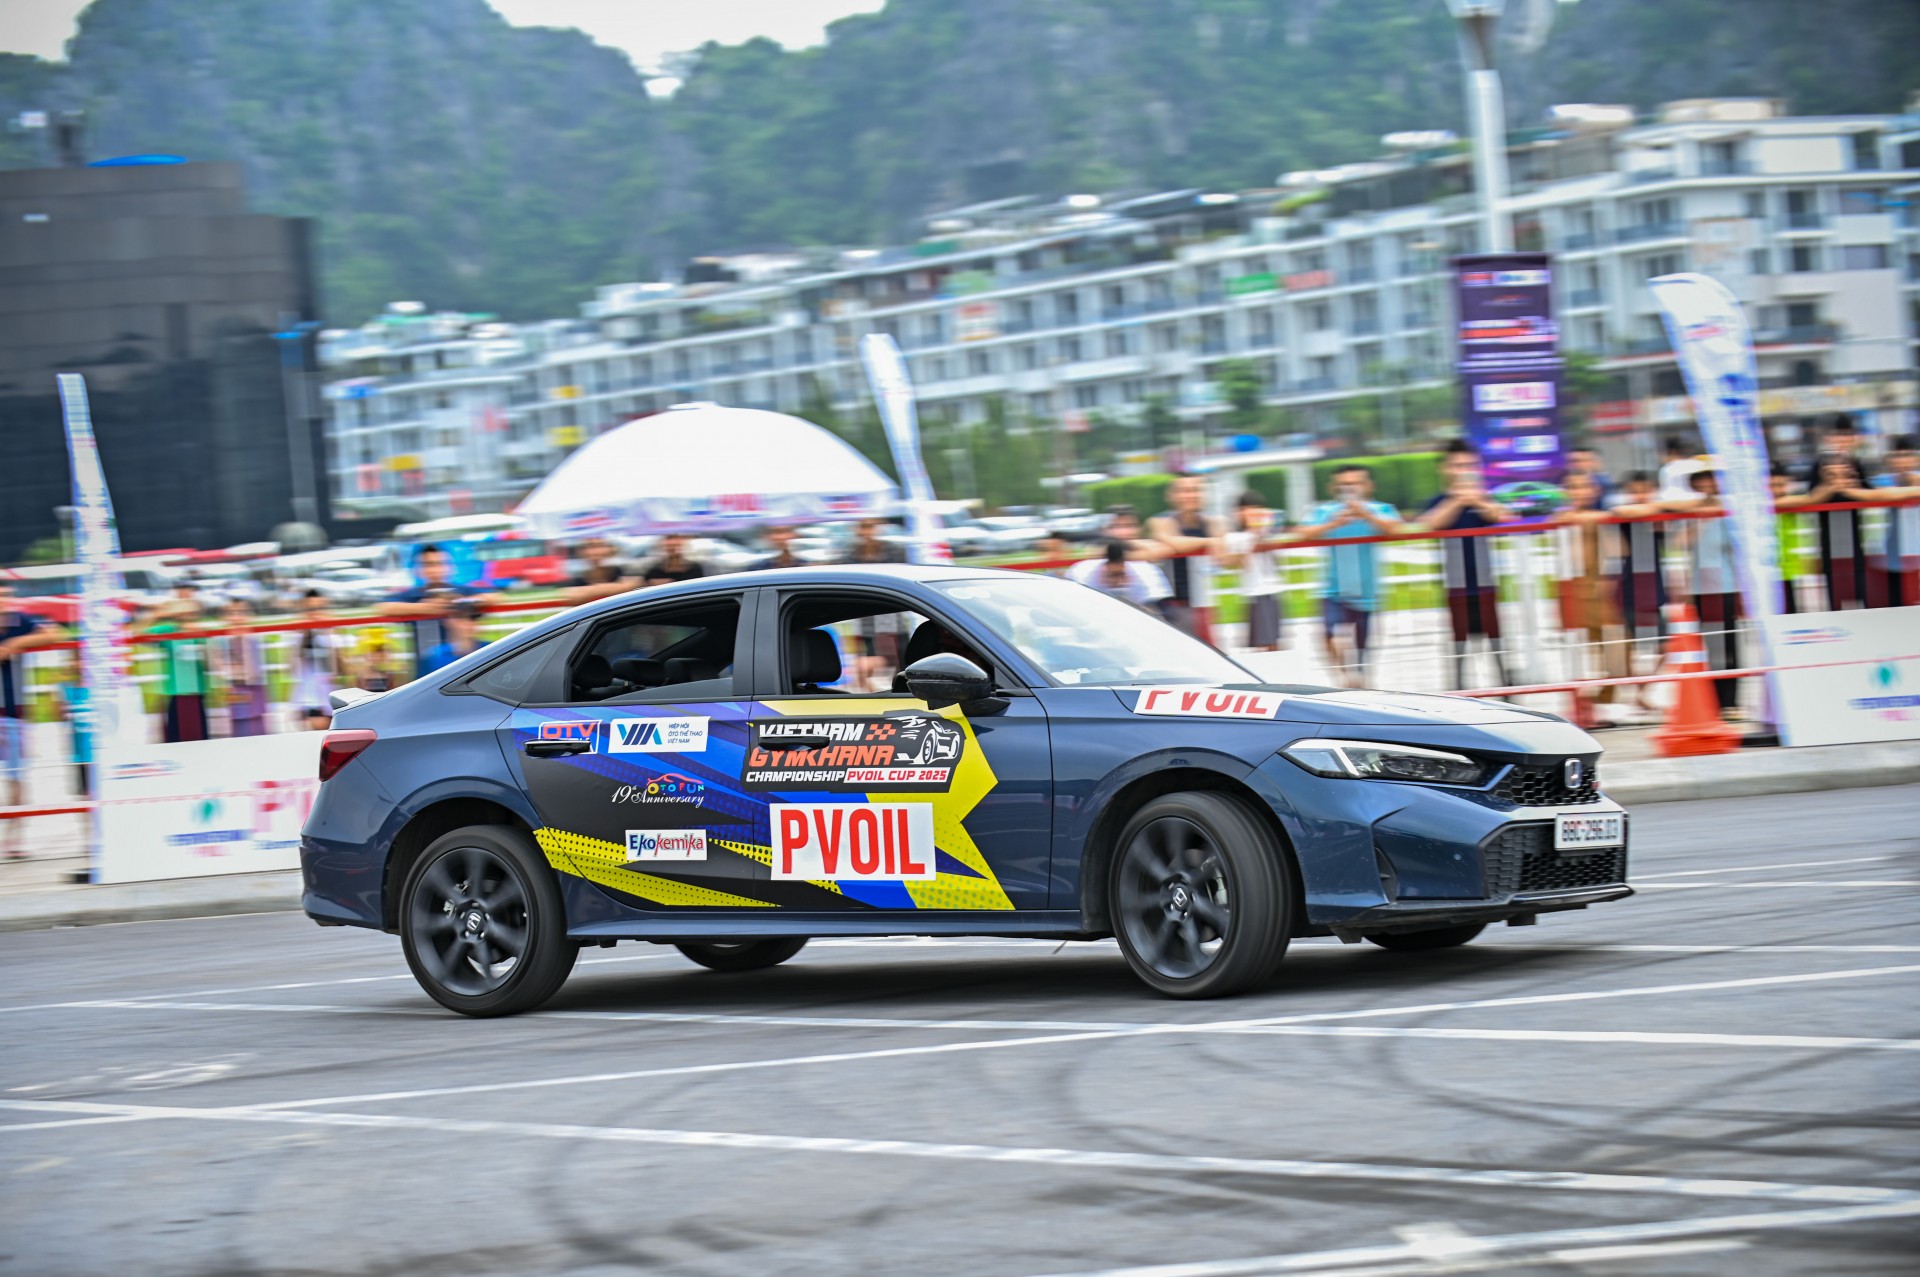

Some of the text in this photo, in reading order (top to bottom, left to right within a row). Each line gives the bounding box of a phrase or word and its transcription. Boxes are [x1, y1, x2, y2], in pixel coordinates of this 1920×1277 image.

[543, 723, 596, 738] OTV
[759, 723, 865, 741] VIETNAM
[749, 745, 896, 767] GYMKHANA
[746, 770, 947, 782] CHAMPIONSHIP PVOIL CUP 2025
[631, 788, 705, 808] Anniversary
[629, 834, 705, 857] Ekokemika
[779, 808, 926, 876] PVOIL
